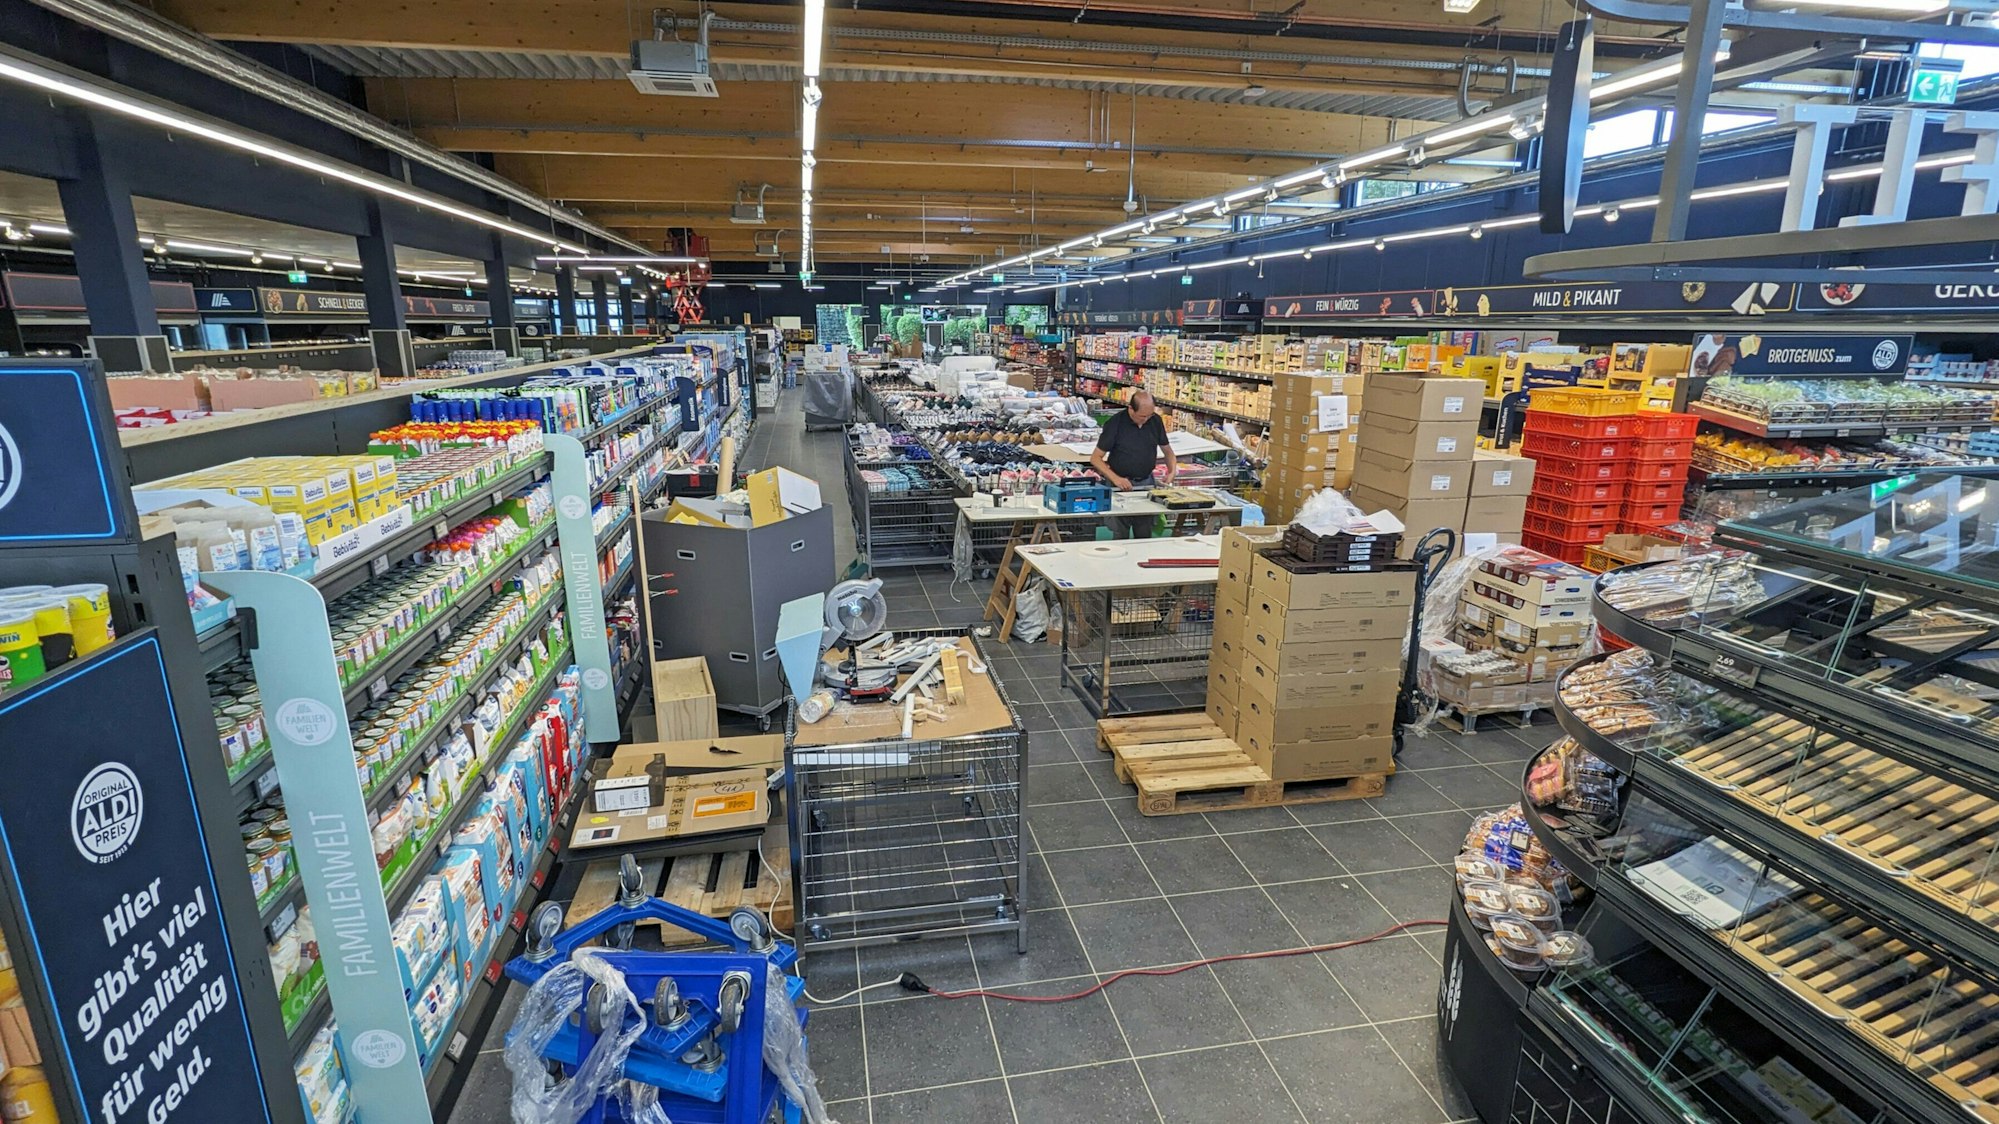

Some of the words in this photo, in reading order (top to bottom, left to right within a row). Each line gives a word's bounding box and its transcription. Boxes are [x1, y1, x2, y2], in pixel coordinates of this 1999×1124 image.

[318, 297, 342, 309] SCHNELL
[347, 298, 365, 309] LECKER
[1316, 301, 1329, 311] FEIN
[1335, 299, 1359, 312] WÜRZIG
[1533, 291, 1560, 307] MILD
[1563, 292, 1571, 307] &
[1574, 289, 1622, 306] PIKANT
[1768, 348, 1834, 363] BROTGENUSS
[1835, 355, 1852, 363] zum
[1876, 350, 1895, 361] ALDI
[305, 485, 324, 498] Bebivita
[380, 518, 402, 535] Bebivita
[333, 538, 358, 558] Bebivita
[571, 551, 597, 640] FAMILIENWELT
[838, 590, 858, 606] metabo
[1716, 655, 1735, 666] 2,69
[285, 714, 327, 725] FAMILIEN
[295, 724, 319, 734] WELT
[83, 779, 128, 805] ORIGINAL
[81, 789, 137, 837] ALDI
[95, 822, 127, 847] PREIS
[99, 854, 114, 864] SEIT
[115, 845, 128, 859] 1913
[311, 811, 377, 976] FAMILIENWELT
[102, 876, 162, 947] Hier
[77, 940, 158, 1042] gibt's
[158, 885, 207, 949] viel
[102, 941, 209, 1066] Qualität
[101, 1062, 146, 1124] für
[149, 974, 228, 1073] wenig
[359, 1042, 397, 1052] FAMILIEN
[369, 1050, 390, 1058] WELT
[147, 1044, 212, 1124] Geld.
